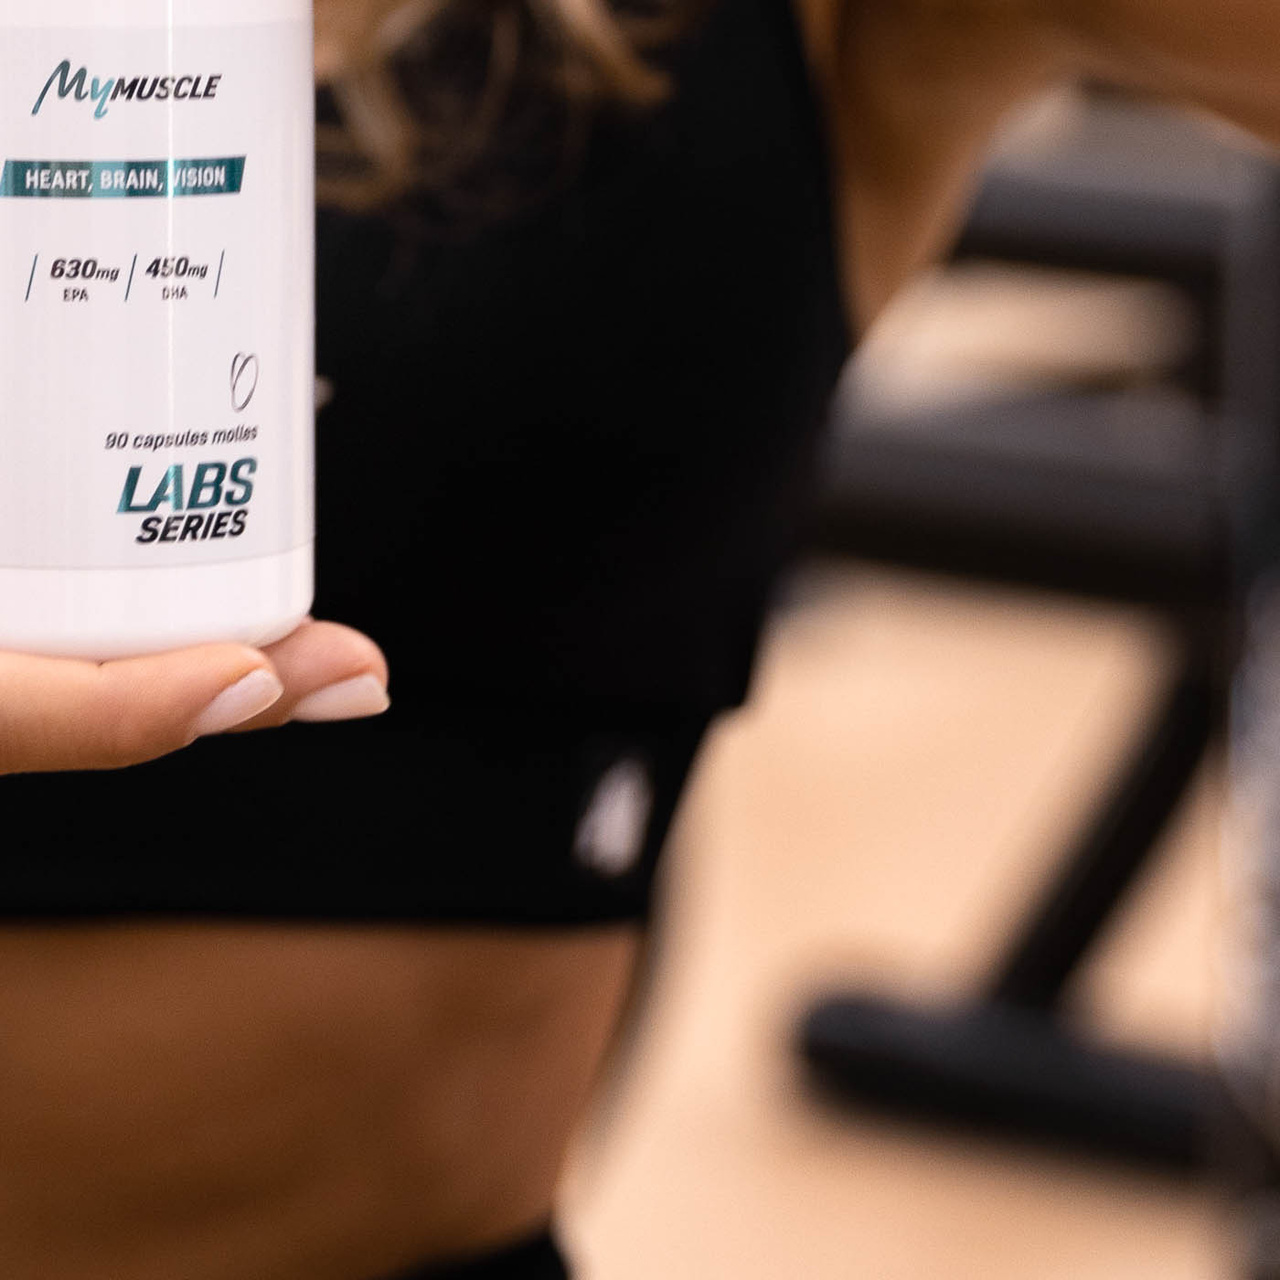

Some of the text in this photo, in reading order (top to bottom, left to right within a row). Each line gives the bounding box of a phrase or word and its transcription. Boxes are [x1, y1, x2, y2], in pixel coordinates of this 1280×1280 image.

[31, 59, 222, 120] MyMUSCLE
[25, 166, 226, 193] HEART, BRAIN, VISION
[50, 258, 120, 282] 630mg
[145, 256, 208, 280] 450mg
[63, 287, 88, 302] EPA
[161, 285, 188, 301] DHA
[105, 424, 258, 452] 90 capsules molles
[117, 457, 258, 513] LABS
[135, 509, 248, 545] SERIES
